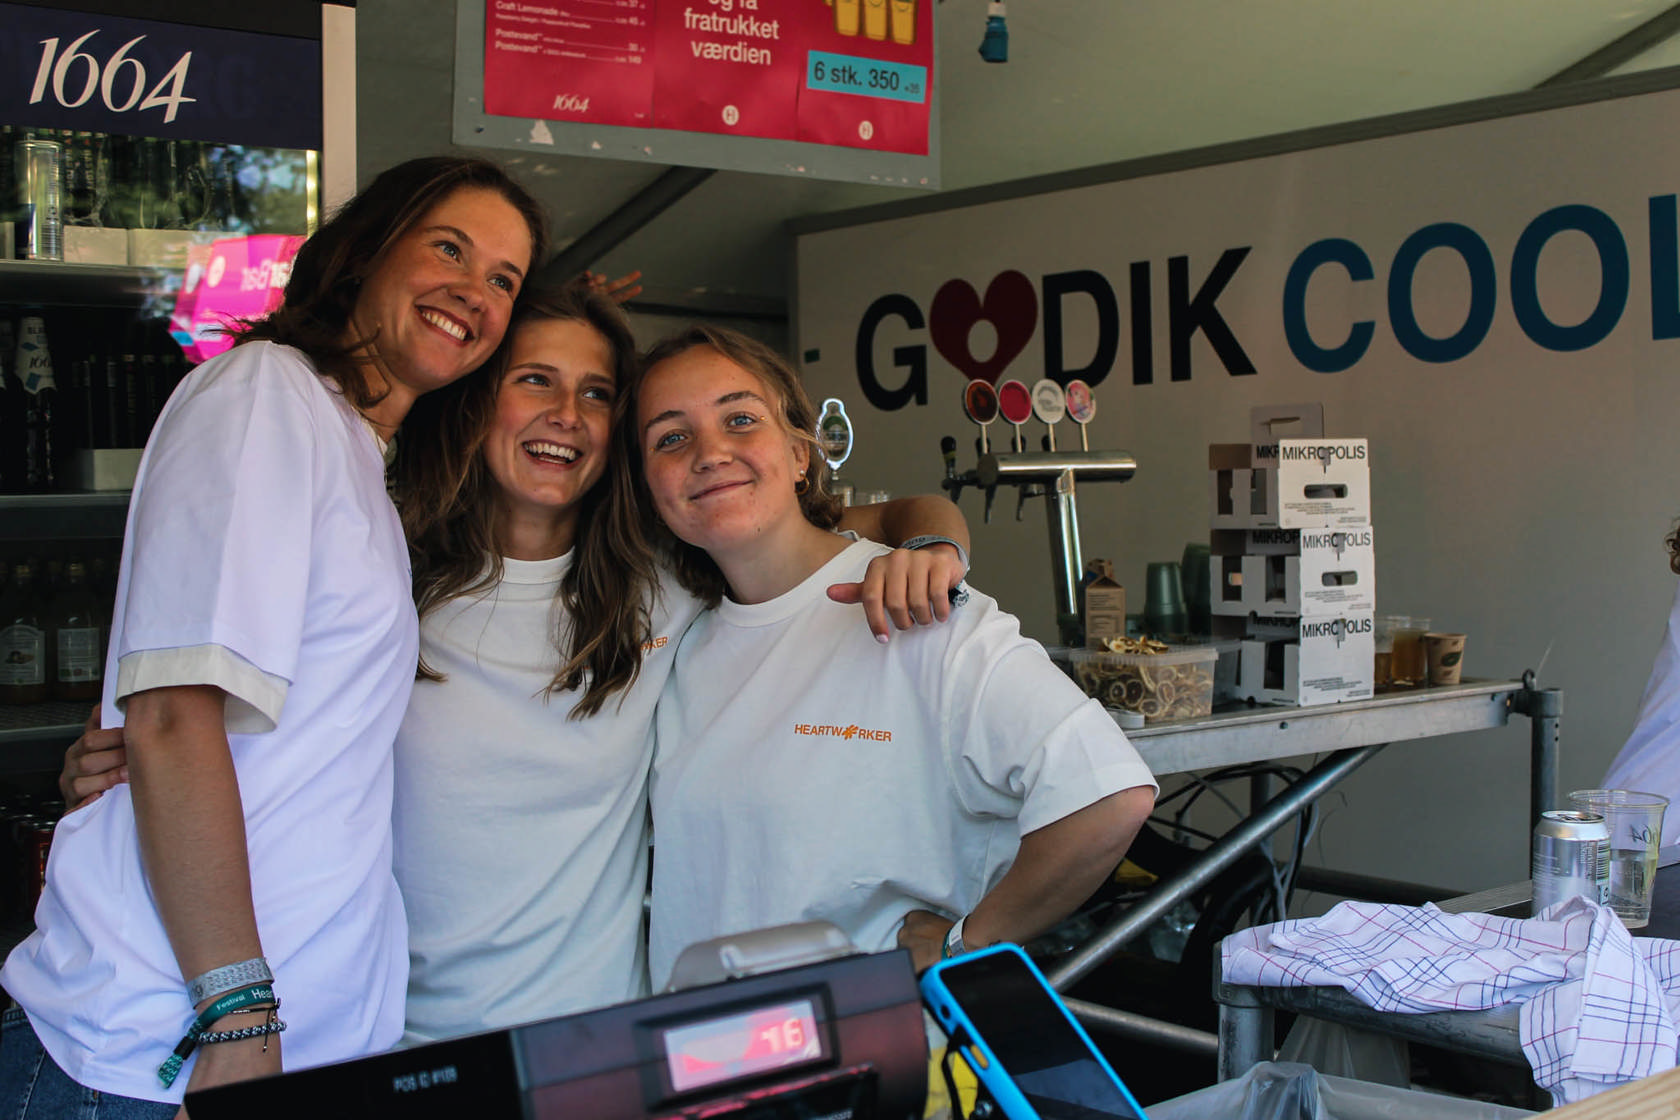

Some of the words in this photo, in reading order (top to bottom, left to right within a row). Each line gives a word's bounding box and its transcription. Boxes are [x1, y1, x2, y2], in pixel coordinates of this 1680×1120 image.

[684, 7, 780, 39] fratrukket
[691, 41, 772, 65] værdien
[29, 29, 196, 123] 1664
[814, 60, 825, 81] 6
[831, 65, 862, 86] stk.
[868, 68, 900, 91] 350
[553, 95, 590, 113] 1664
[1302, 532, 1371, 549] MIKROOLIS
[1302, 619, 1372, 638] MIKROOLIS
